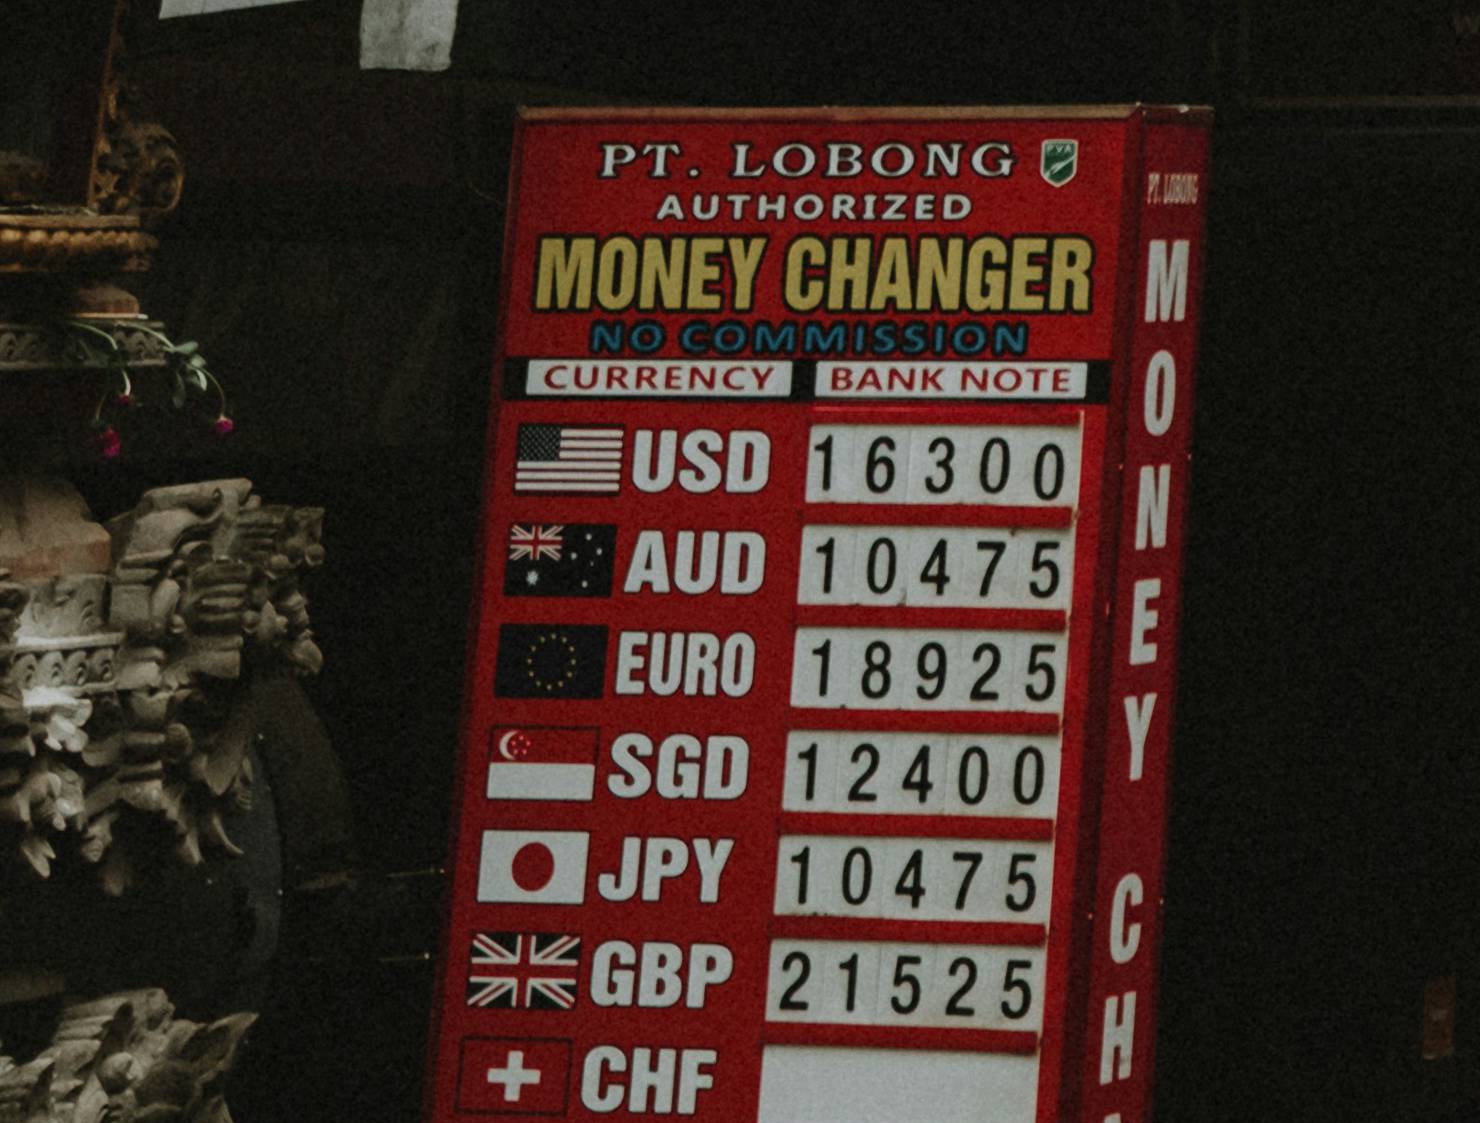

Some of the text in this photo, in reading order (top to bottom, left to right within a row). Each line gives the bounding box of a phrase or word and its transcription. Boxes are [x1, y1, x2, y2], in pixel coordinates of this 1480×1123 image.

[600, 141, 1017, 179] PT. LOBONG
[656, 193, 974, 222] AUTHORIZED
[532, 235, 1094, 315] MONEY CHANGER
[590, 321, 1029, 356] NO COMMISSION
[543, 365, 775, 392] CURRENCY
[831, 368, 1071, 393] BANK NOTE
[631, 429, 773, 494] USD
[815, 434, 1064, 502] 16300
[1123, 239, 1190, 782] MONEY
[621, 530, 767, 594] AUD
[815, 539, 1061, 598] 10475
[615, 630, 757, 698] EURO
[812, 639, 1057, 702] 18925
[606, 731, 750, 801] SGD
[798, 743, 1045, 805] 12400
[598, 836, 735, 904] JPY
[790, 847, 1037, 912] 10475
[589, 940, 734, 1009] GBP
[780, 951, 1034, 1020] 21525
[579, 1044, 719, 1116] CHF
